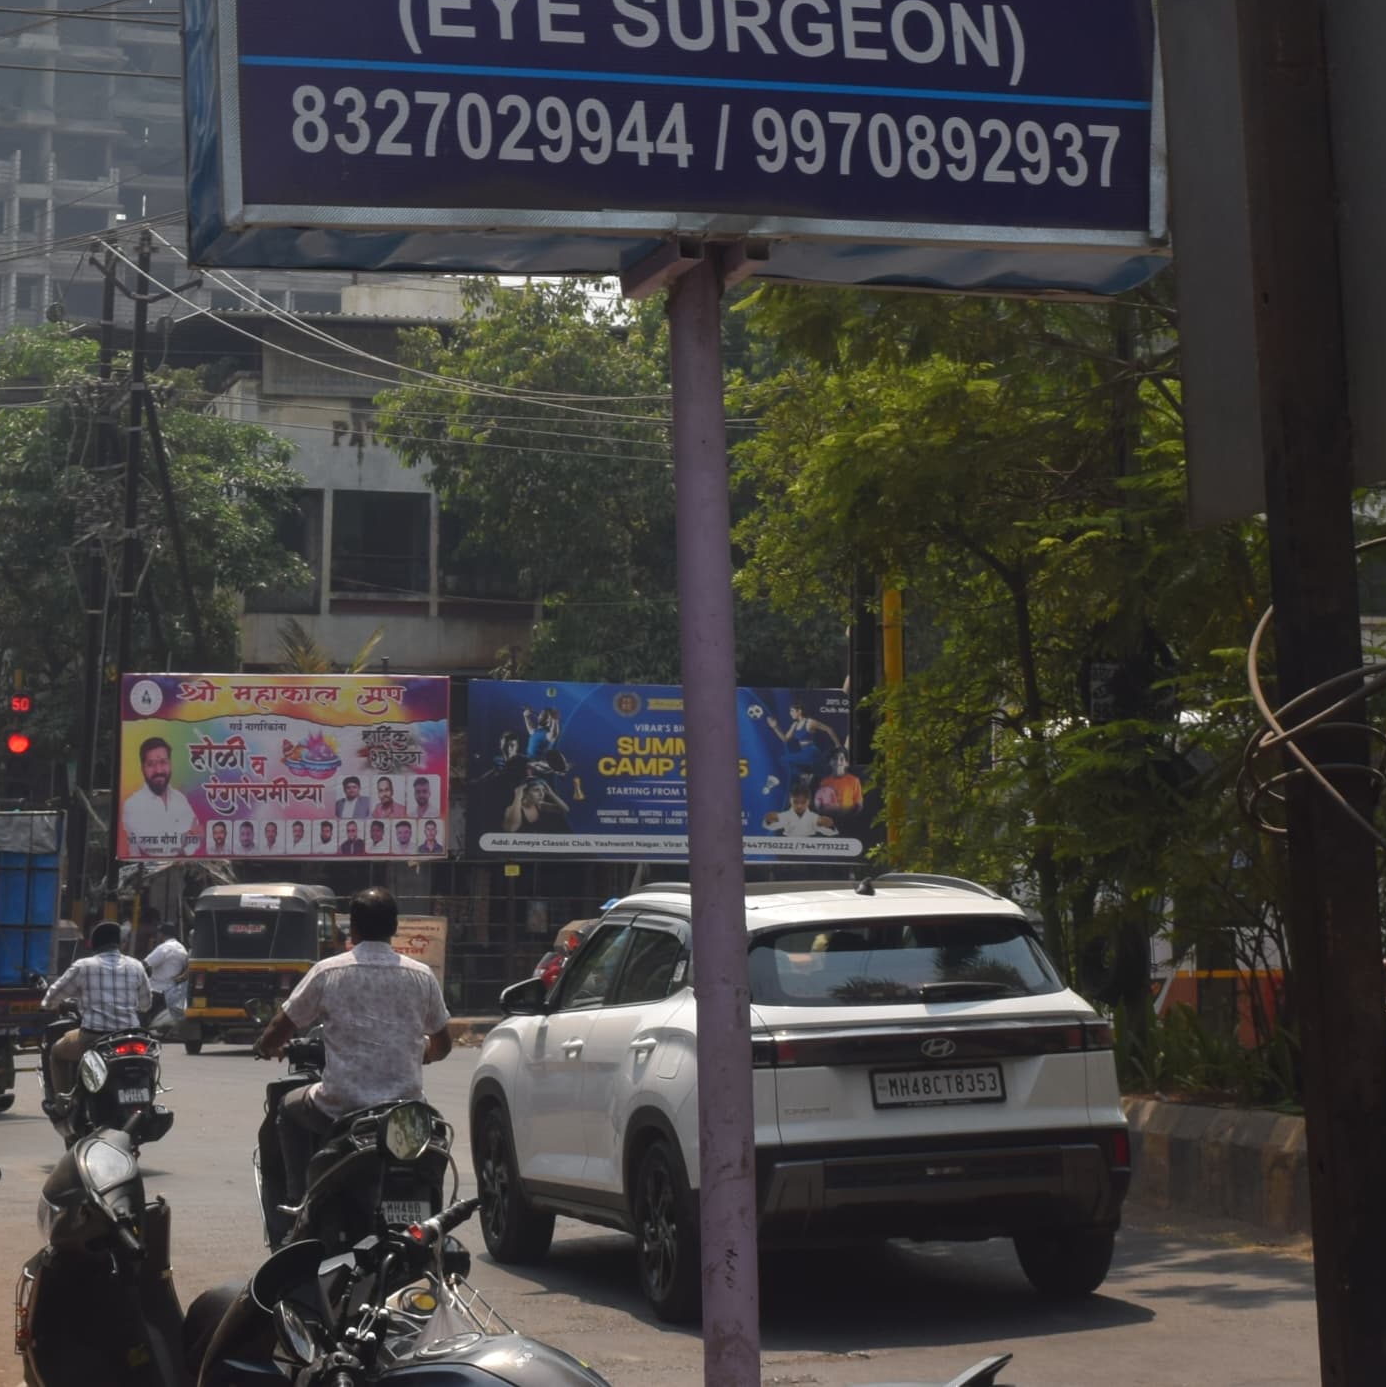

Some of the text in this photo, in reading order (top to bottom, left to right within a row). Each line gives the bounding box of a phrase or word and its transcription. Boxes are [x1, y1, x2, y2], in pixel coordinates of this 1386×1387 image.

[292, 85, 1121, 187] 8327029944 / 9970892937
[177, 679, 221, 702] श्री
[232, 685, 341, 709] महाकाल
[12, 697, 30, 711] 50
[362, 725, 410, 744] हार्दिक
[634, 724, 670, 732] VIRAR'S
[617, 736, 686, 755] SUMM
[189, 735, 267, 776] होळी व
[598, 757, 674, 776] CAMP
[204, 776, 326, 813] रंगपंचमीच्या
[606, 787, 650, 795] STARTING
[653, 788, 680, 796] FROM
[888, 1073, 998, 1097] MH48CT8353
